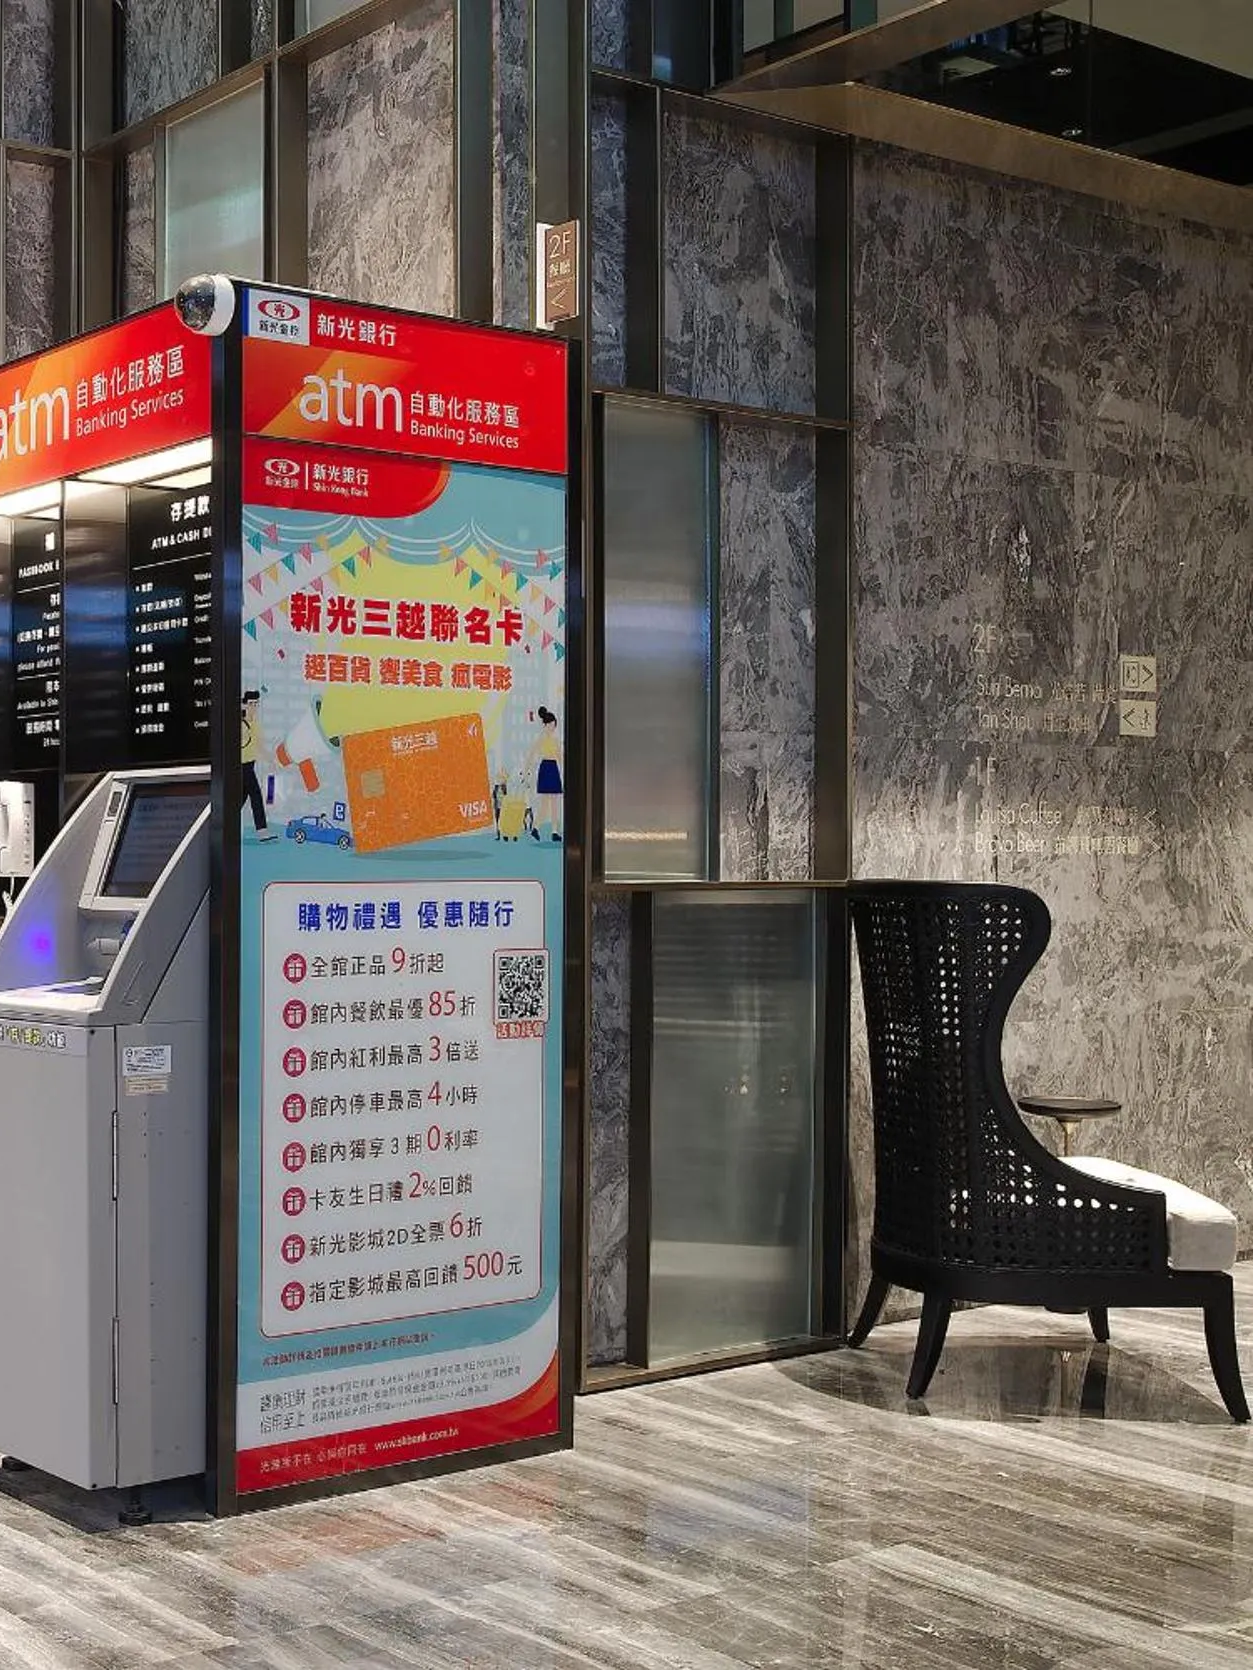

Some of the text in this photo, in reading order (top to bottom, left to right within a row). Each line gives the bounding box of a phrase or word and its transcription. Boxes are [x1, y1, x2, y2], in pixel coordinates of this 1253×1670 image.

[550, 231, 572, 259] 2F
[317, 313, 397, 347] 新光銀行
[77, 344, 184, 411] 自動化服務區
[77, 389, 183, 436] Banking Services
[300, 369, 402, 432] atm
[411, 390, 519, 429] 自動化服務區
[410, 421, 519, 449] Banking Services
[313, 463, 369, 486] 新光銀行
[177, 529, 200, 544] CASH
[289, 591, 523, 647] 新光三越聯名卡
[304, 654, 514, 692] 逛百貨 饗美食 瘋電影
[459, 800, 487, 817] VISA
[298, 900, 514, 931] 購物禮遇 優惠隨行
[311, 947, 444, 978] 全館正品9折起
[310, 991, 476, 1025] 館內餐飲最優85折
[310, 1036, 479, 1071] 館內紅利最高3倍送
[310, 1081, 478, 1118] 館內停車最高4小時
[309, 1251, 523, 1304] 指定影城最高回饋500元
